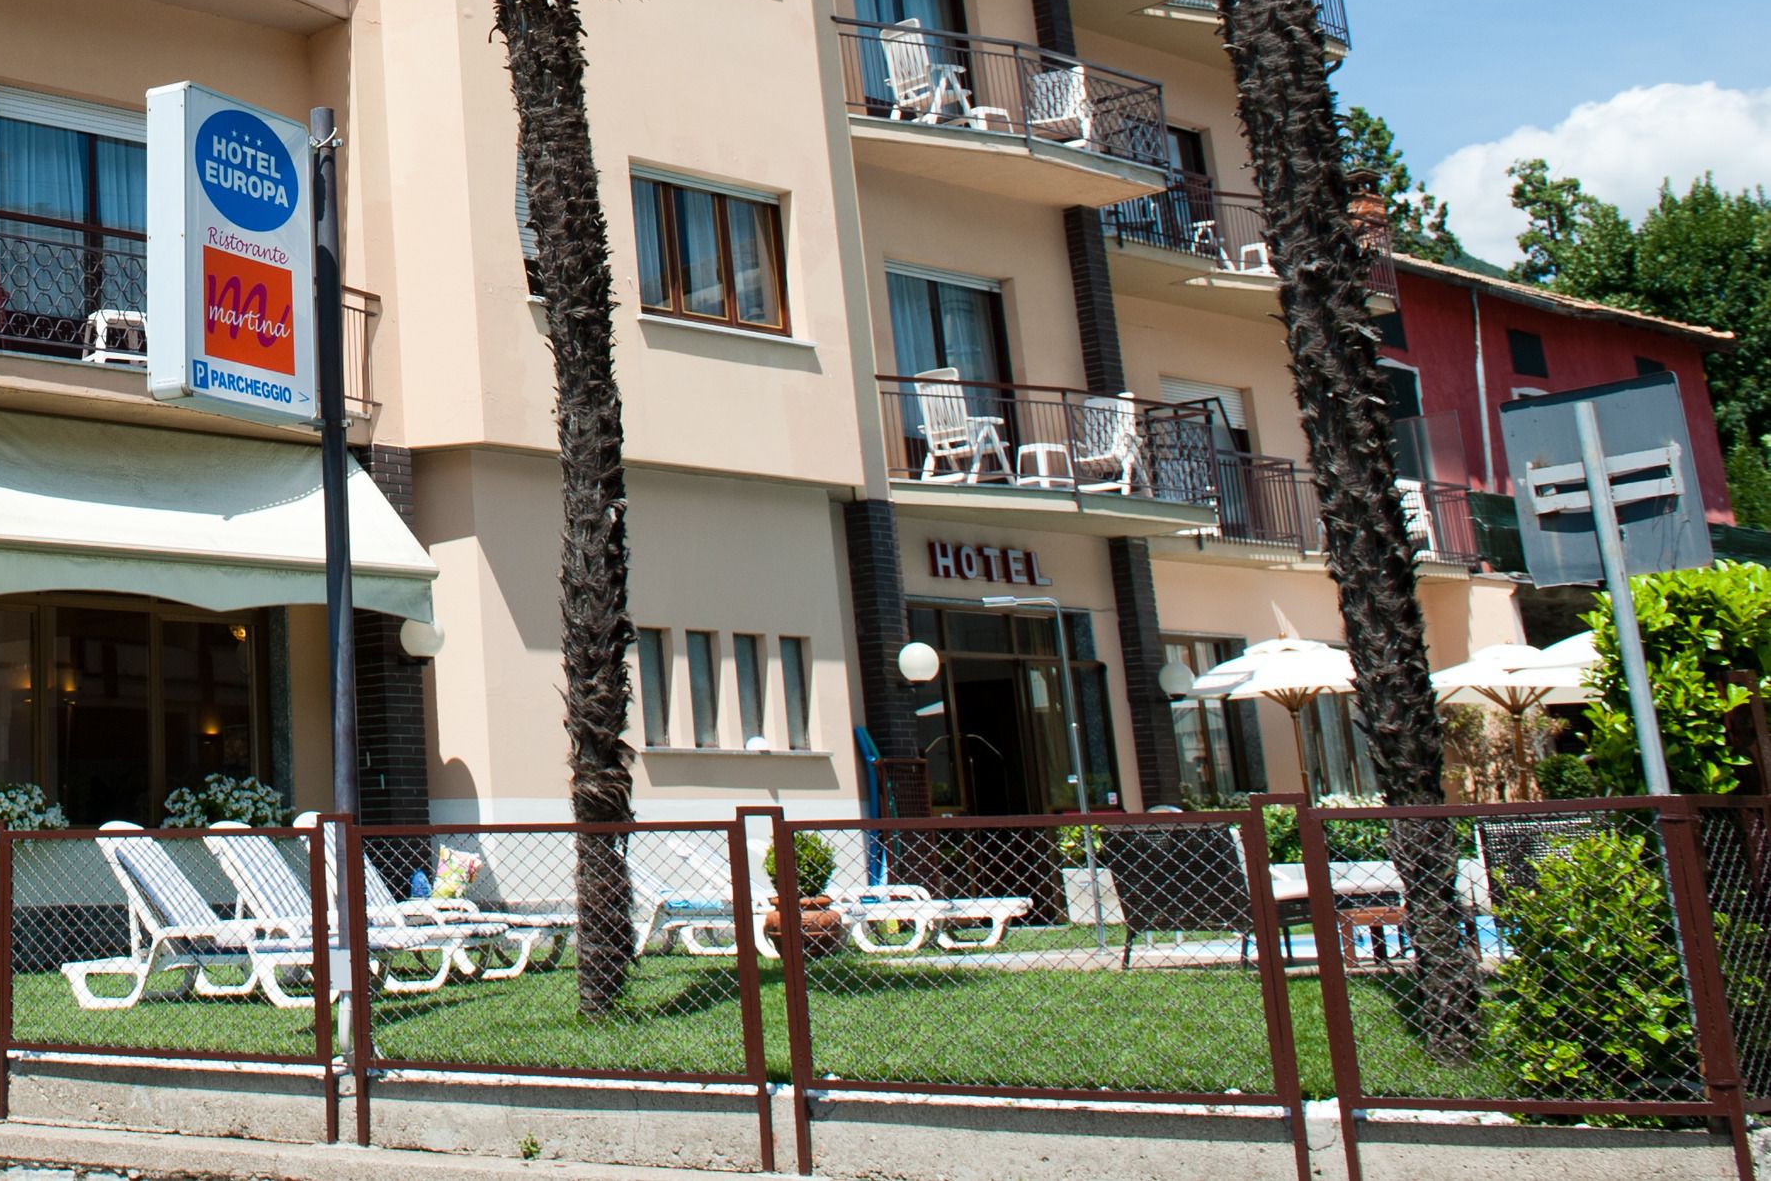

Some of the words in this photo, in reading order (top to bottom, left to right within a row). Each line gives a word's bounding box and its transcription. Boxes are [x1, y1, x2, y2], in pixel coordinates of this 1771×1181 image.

[212, 135, 281, 179] HOTEL
[205, 159, 289, 208] EUROPA
[208, 226, 289, 265] Ristorante
[209, 305, 291, 338] martina
[196, 363, 205, 386] P
[211, 369, 292, 404] PARCHEGGIO
[929, 540, 1052, 586] HOTEL
